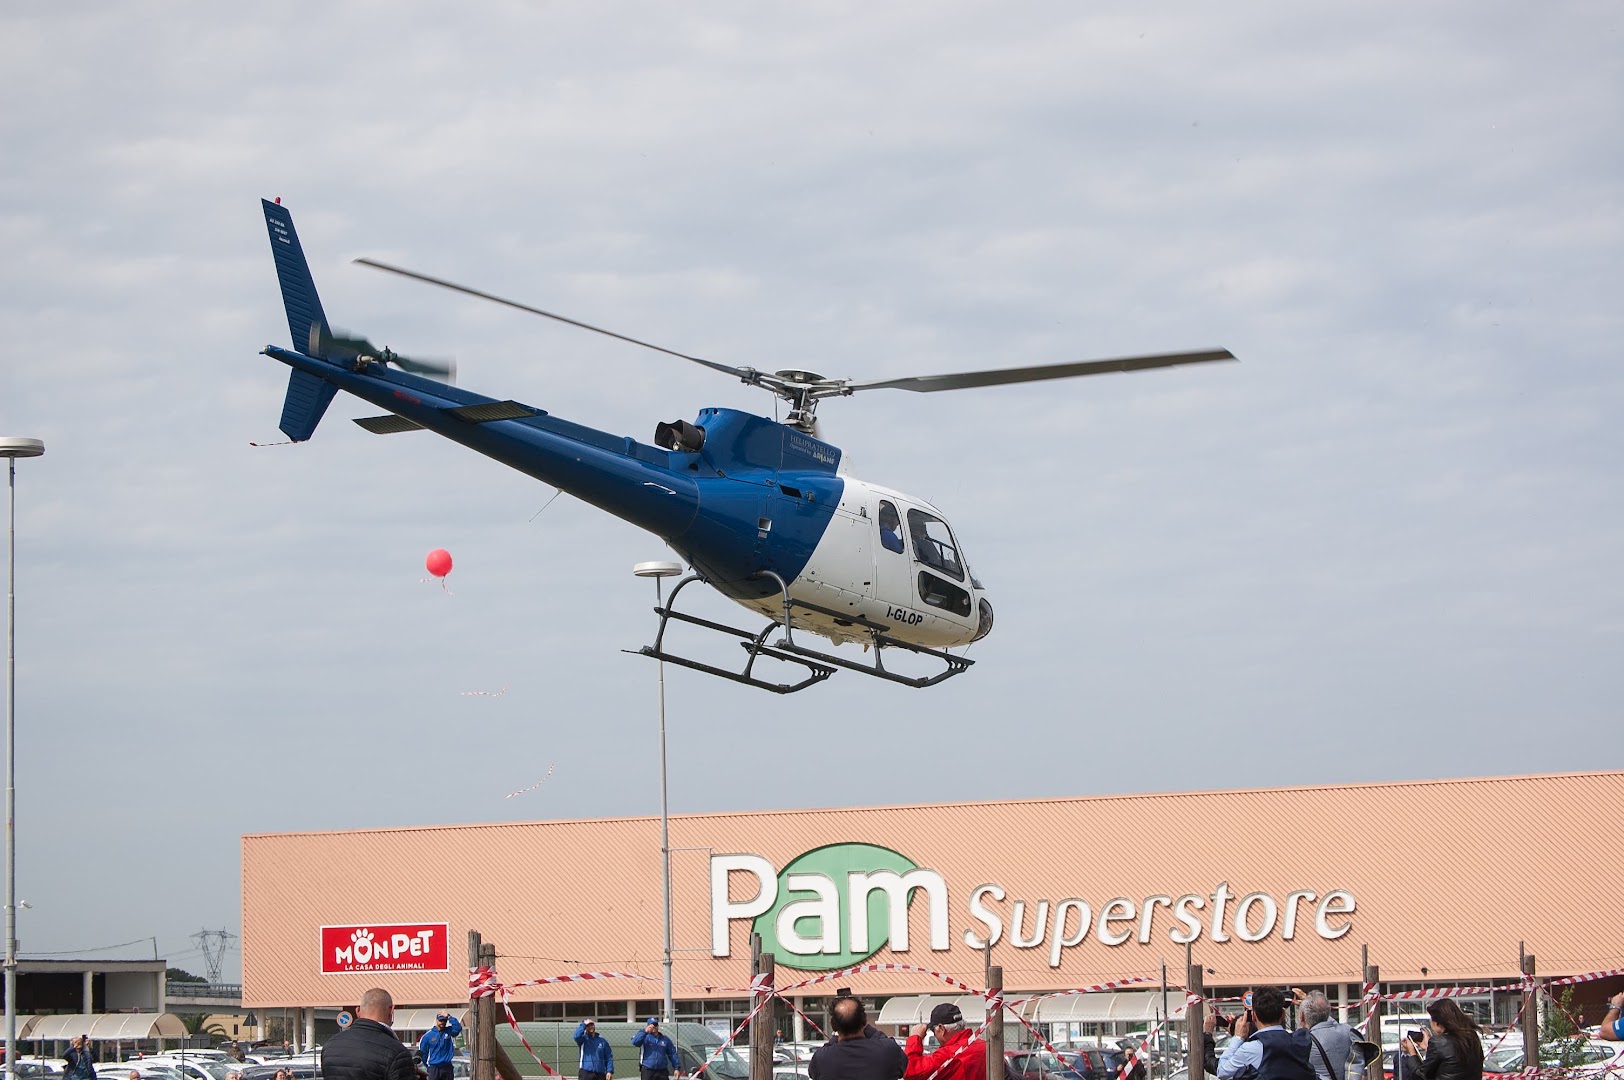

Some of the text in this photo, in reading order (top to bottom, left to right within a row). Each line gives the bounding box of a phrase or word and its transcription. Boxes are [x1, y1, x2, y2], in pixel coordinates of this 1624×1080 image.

[791, 435, 836, 457] HELIPRATELLO
[886, 605, 923, 626] I-GLOP
[710, 853, 1356, 967] Pam Superstore
